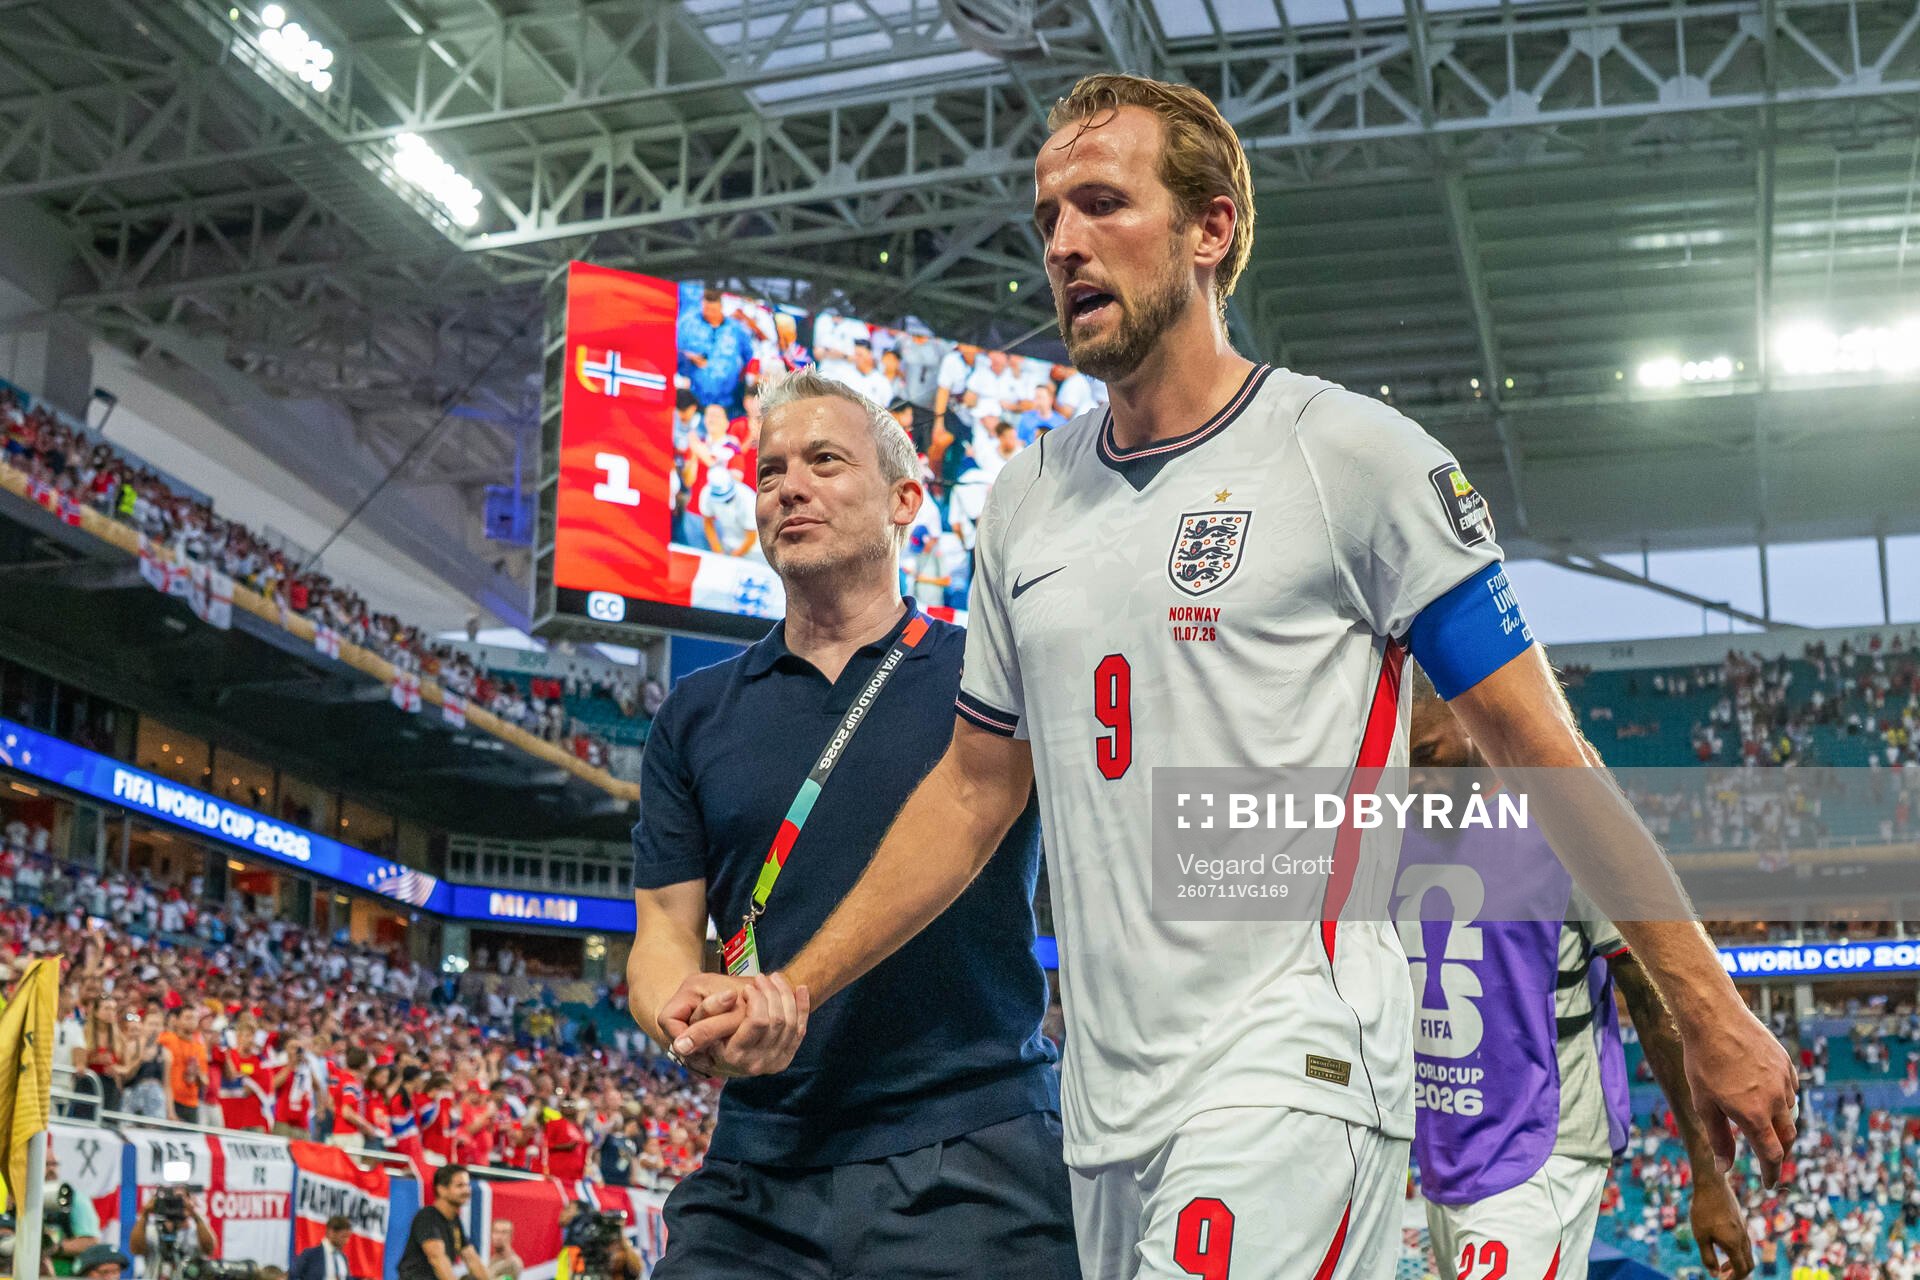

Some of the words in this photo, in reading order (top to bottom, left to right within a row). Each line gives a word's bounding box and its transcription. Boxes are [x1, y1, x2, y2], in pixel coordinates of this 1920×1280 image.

[593, 452, 641, 506] 1
[594, 599, 619, 616] CC
[1168, 607, 1221, 622] NORWAY
[1173, 626, 1216, 642] 11.07.26
[881, 649, 903, 671] FIFA
[859, 670, 890, 707] WORLD
[845, 707, 863, 730] CUP
[1094, 653, 1132, 780] 9
[820, 728, 849, 770] 2026
[113, 768, 155, 808] FIFA
[155, 783, 221, 829] WORLD
[220, 808, 257, 841] CUP
[253, 821, 311, 861] 2026
[489, 892, 578, 923] MIAMI
[1738, 949, 1822, 972] WORLD
[1823, 947, 1872, 969] CUP
[1874, 945, 1920, 967] 20
[1421, 1019, 1452, 1040] FIFA
[1448, 1066, 1484, 1084] CUP
[1415, 1081, 1484, 1117] 2026
[211, 1191, 289, 1219] COUNTY
[1173, 1197, 1235, 1280] 9
